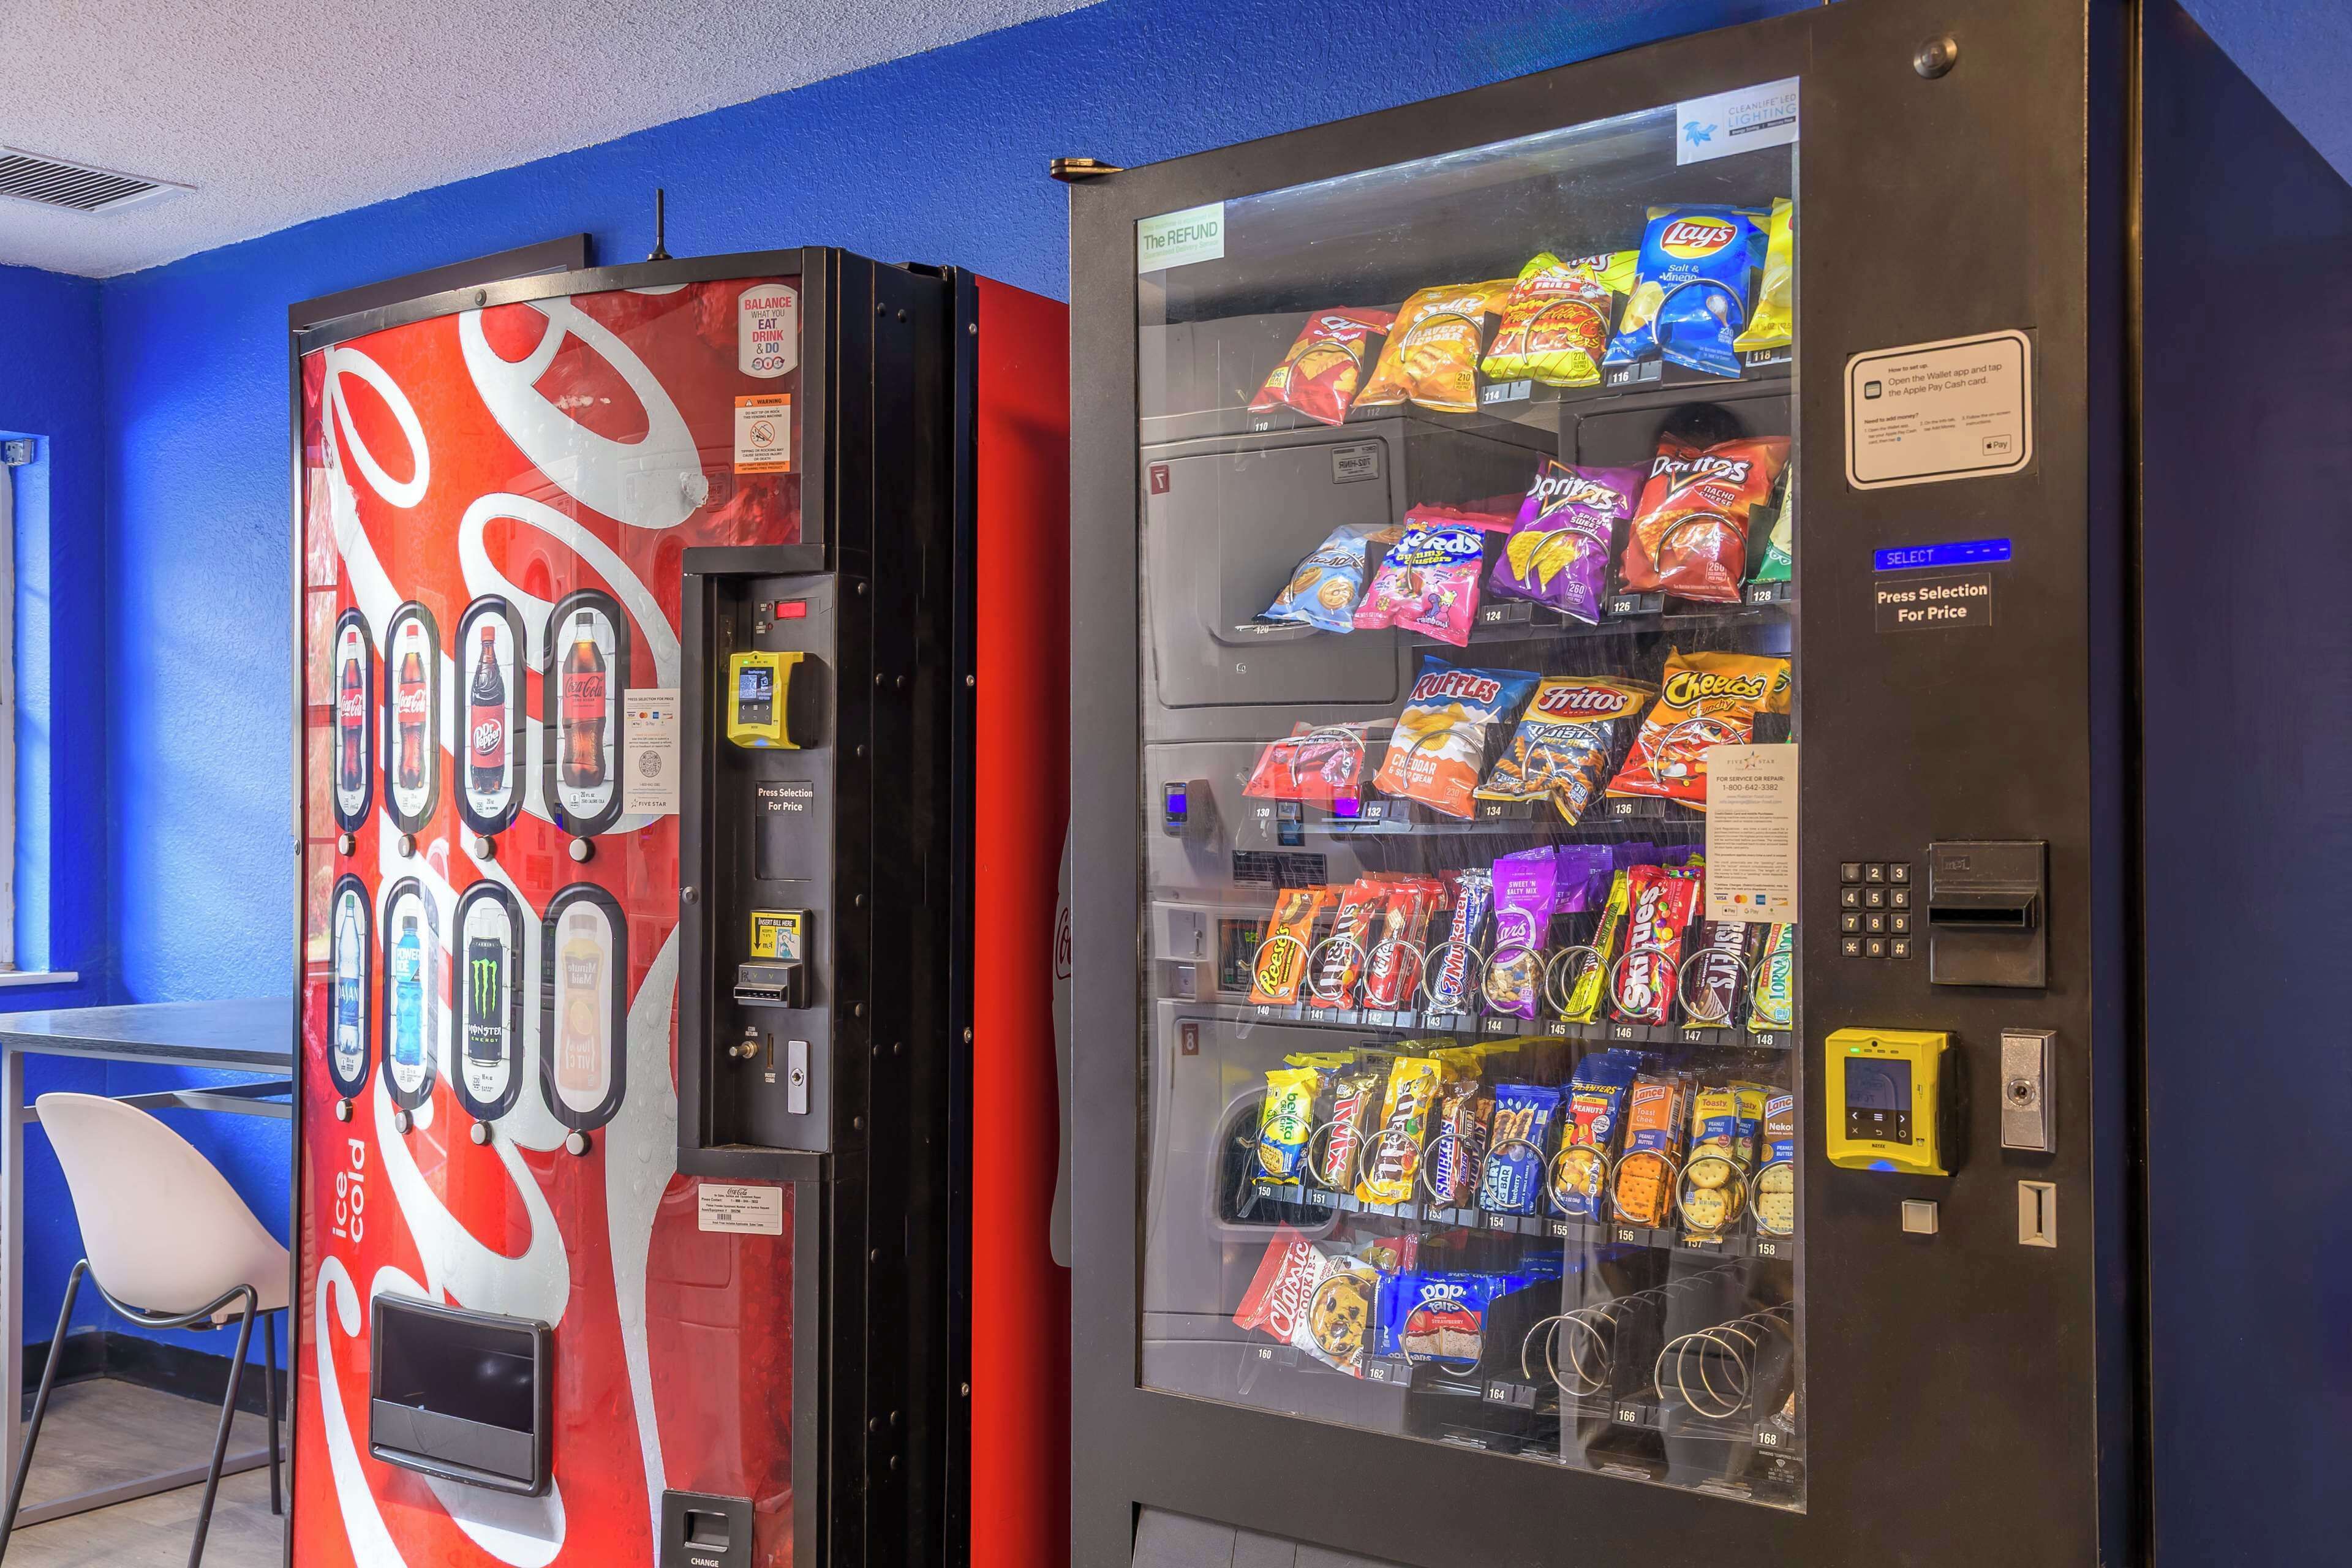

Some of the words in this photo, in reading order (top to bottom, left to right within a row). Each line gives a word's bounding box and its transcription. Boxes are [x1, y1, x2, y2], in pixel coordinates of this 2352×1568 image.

[1780, 94, 1796, 104] LED
[1728, 103, 1797, 127] LIGHTING
[1144, 234, 1165, 250] The
[1167, 221, 1218, 246] REFUND
[1665, 222, 1736, 249] Lay's
[1668, 264, 1691, 273] Salt
[1691, 265, 1699, 273] &
[744, 296, 792, 310] BALANCE
[751, 309, 770, 318] WHAT
[772, 309, 785, 317] YOU
[752, 330, 783, 342] DRINK
[1719, 327, 1733, 336] 230
[756, 343, 764, 354] &
[765, 342, 779, 353] DO
[1753, 350, 1771, 361] 118
[1457, 373, 1470, 382] 210
[1612, 372, 1629, 383] 116
[1888, 376, 1910, 388] Open
[1912, 375, 1926, 383] the
[1926, 370, 1951, 381] Wallet
[1953, 369, 1969, 381] app
[1970, 365, 1986, 374] and
[1988, 363, 2002, 374] tap
[1888, 388, 1902, 398] the
[1903, 385, 1926, 396] Apple
[1928, 382, 1943, 393] Pay
[1945, 379, 1966, 390] Cash
[1967, 376, 1988, 386] card.
[1484, 391, 1499, 402] 114
[1366, 407, 1380, 417] 112
[1897, 412, 1919, 422] money?
[1255, 421, 1268, 432] 110
[1993, 440, 2008, 450] Pay
[1703, 485, 1735, 500] NACHO
[1698, 491, 1733, 507] CHEESE
[1570, 516, 1601, 530] SWEET
[1577, 512, 1602, 524] SPICY
[1887, 549, 1934, 565] SELECT
[1708, 562, 1725, 571] 260
[1569, 584, 1585, 594] 260
[1877, 591, 1916, 604] Press
[1919, 584, 1988, 600] Selection
[1754, 590, 1771, 601] 128
[1614, 601, 1630, 612] 126
[1485, 611, 1501, 622] 124
[1898, 608, 1924, 622] For
[1928, 605, 1967, 620] Price
[1416, 616, 1449, 628] rainbow
[1256, 625, 1269, 635] 120
[1409, 671, 1500, 703] RUFFLES
[1665, 671, 1764, 706] Cheetos
[1538, 686, 1629, 711] Fritos
[1688, 699, 1735, 717] Crunchy
[475, 726, 501, 749] Pepper
[1392, 754, 1437, 775] CHEDDAR
[1412, 773, 1433, 785] CREAM
[758, 788, 778, 797] Press
[779, 788, 813, 797] Selection
[1446, 788, 1460, 796] 230
[1574, 783, 1586, 796] 310
[768, 802, 782, 811] For
[783, 802, 803, 812] Price
[1366, 807, 1381, 817] 132
[1485, 806, 1502, 816] 134
[1615, 804, 1632, 814] 136
[1256, 808, 1270, 818] 130
[1871, 869, 1879, 878] 2
[1896, 869, 1903, 878] 3
[1847, 894, 1855, 903] 4
[1872, 894, 1879, 903] 5
[1896, 894, 1903, 903] 6
[758, 917, 772, 926] INSERT
[1847, 919, 1855, 928] 7
[1872, 919, 1879, 928] 8
[1896, 919, 1903, 928] 9
[1443, 886, 1469, 978] Musketeers
[1872, 943, 1879, 953] 0
[396, 948, 420, 960] POWER
[1706, 921, 1746, 990] RSHEY'S
[1259, 925, 1290, 995] Reese's
[1440, 971, 1464, 996] 3
[1768, 960, 1787, 1000] LORNA
[1257, 1006, 1270, 1015] 140
[1311, 1010, 1323, 1019] 141
[1368, 1012, 1382, 1023] 142
[1427, 1017, 1441, 1027] 143
[469, 1023, 502, 1036] MONSTER
[1487, 1020, 1501, 1031] 144
[1550, 1025, 1566, 1034] 145
[1616, 1028, 1632, 1038] 146
[1684, 1031, 1701, 1041] 147
[1756, 1034, 1773, 1045] 148
[1572, 1084, 1618, 1095] PLANTERS
[1635, 1087, 1664, 1101] Lance
[1572, 1104, 1604, 1115] PEANUTS
[1436, 1119, 1455, 1198] SNICKERS
[1460, 1153, 1469, 1186] SNICKERS
[1501, 1169, 1510, 1189] BAR
[348, 1138, 365, 1243] cold
[1258, 1186, 1271, 1196] 150
[333, 1171, 348, 1238] ice
[1313, 1194, 1325, 1204] 151
[1429, 1208, 1442, 1219] 153
[1489, 1216, 1504, 1227] 154
[1553, 1225, 1567, 1235] 155
[1618, 1230, 1634, 1241] 156
[1758, 1243, 1775, 1255] 158
[1270, 1241, 1310, 1336] Classic
[1258, 1348, 1272, 1359] 160
[1370, 1368, 1384, 1379] 162
[1488, 1388, 1505, 1400] 164
[1619, 1410, 1635, 1422] 166
[1758, 1432, 1776, 1445] 168
[690, 1557, 720, 1568] CHANGE
